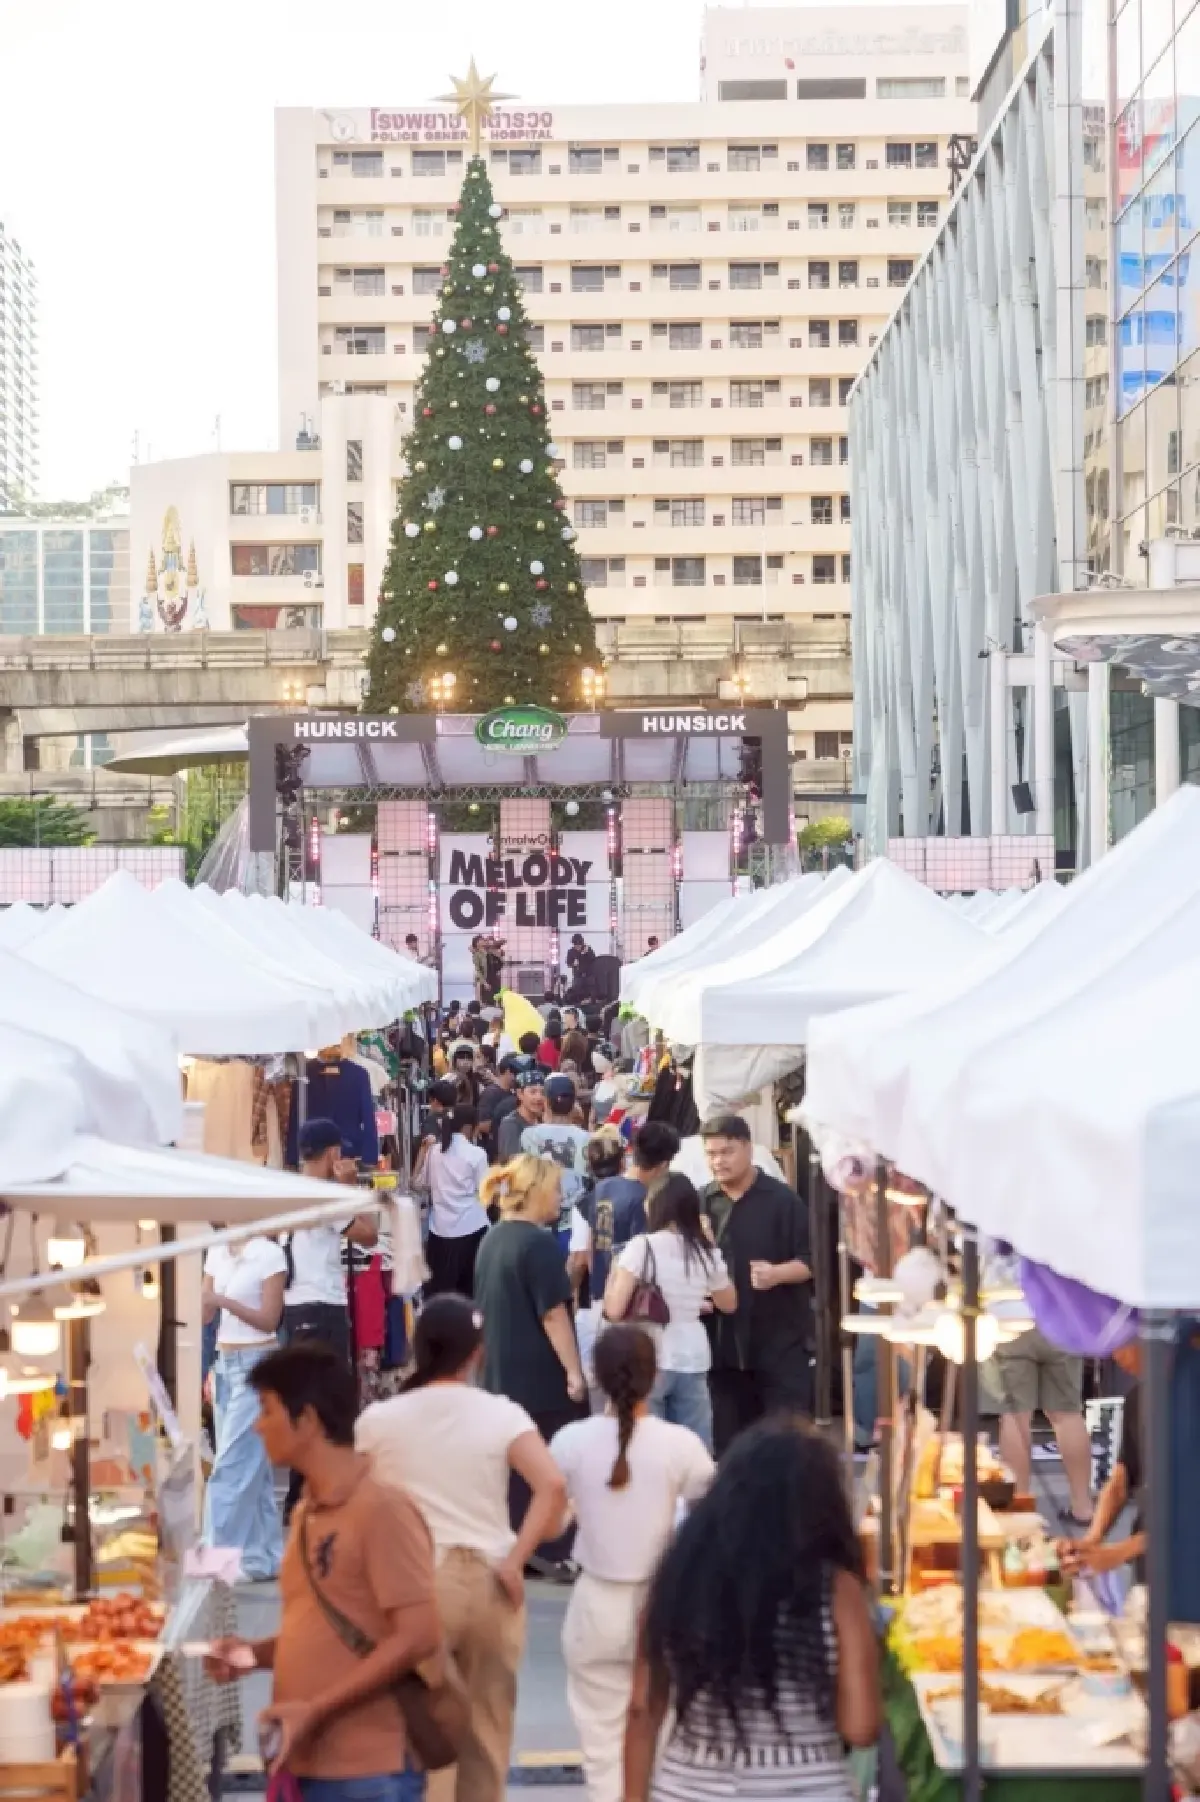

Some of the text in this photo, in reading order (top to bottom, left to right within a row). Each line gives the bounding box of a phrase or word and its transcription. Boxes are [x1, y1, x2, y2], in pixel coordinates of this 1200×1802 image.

[370, 131, 419, 141] POLICE
[490, 129, 553, 140] HOSPITAL
[293, 720, 399, 738] HUNSICK
[488, 719, 553, 742] Chang
[641, 714, 747, 733] HUNSICK
[449, 849, 593, 887] MELODY
[449, 889, 587, 929] OF LIFE
